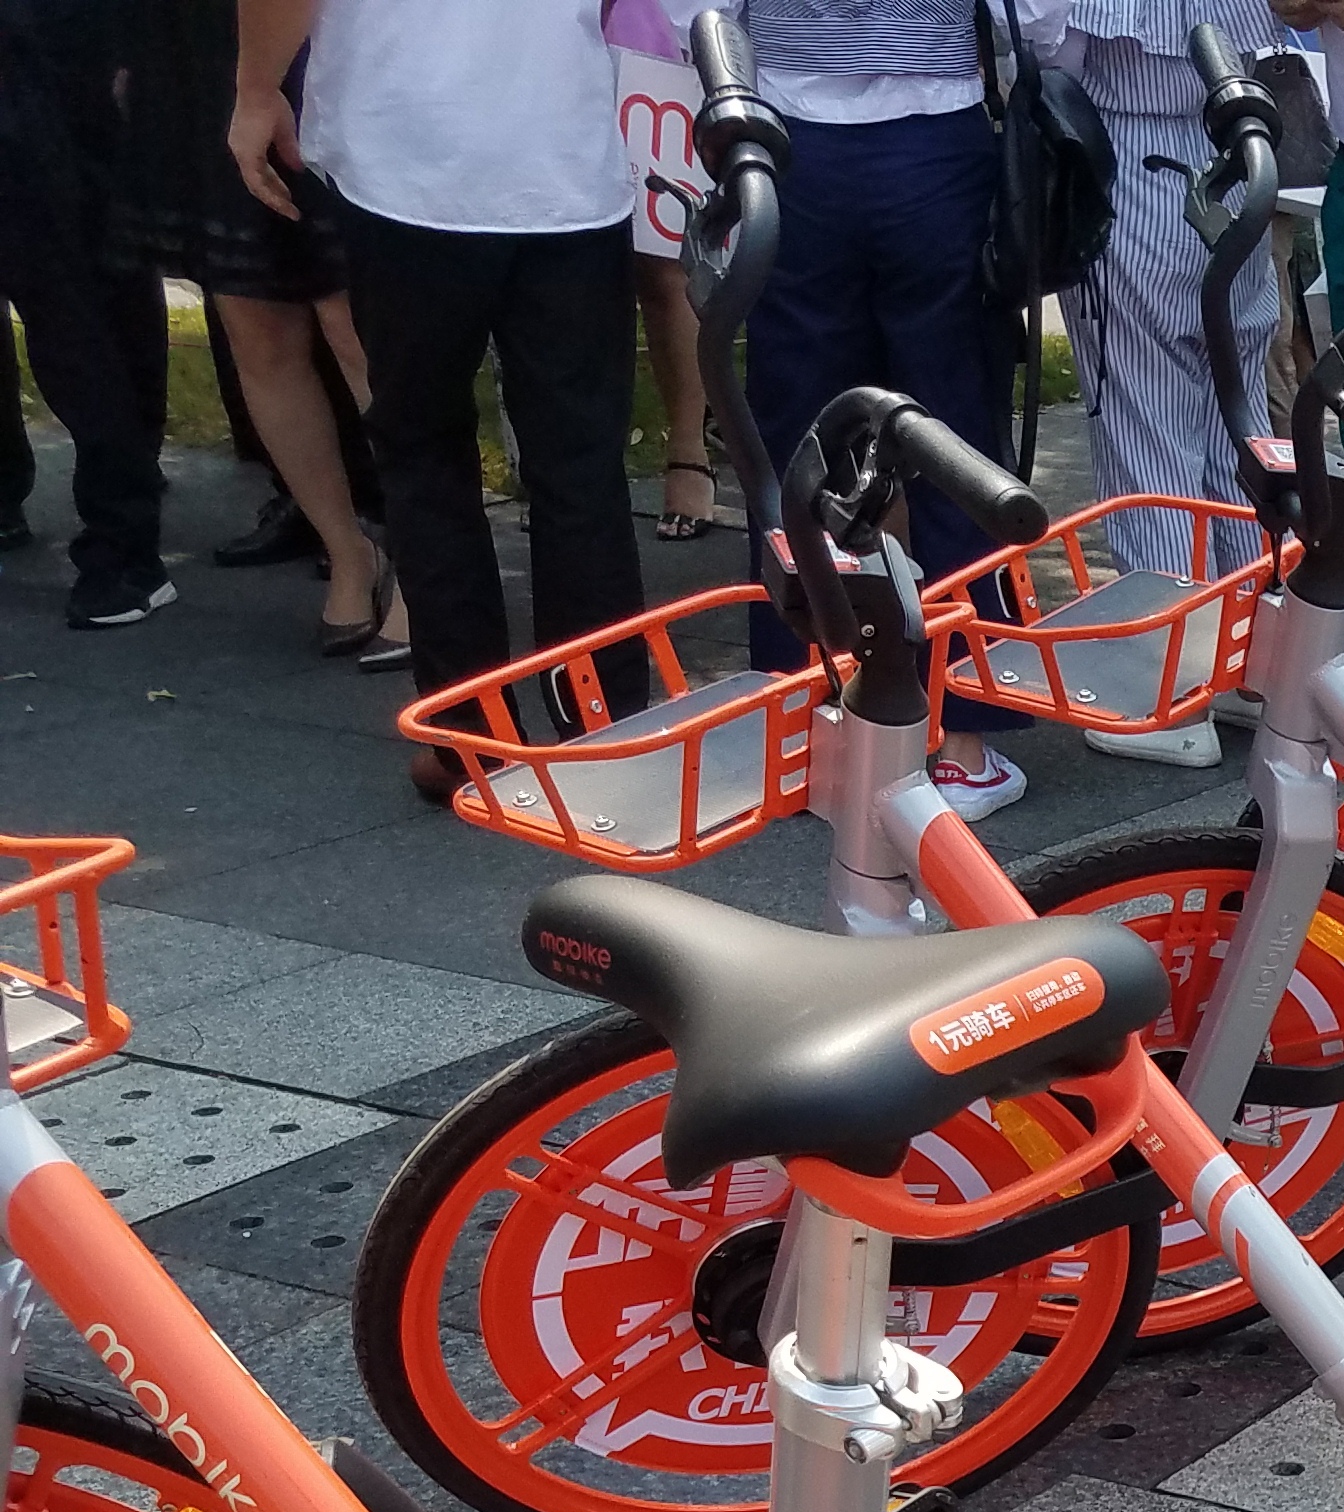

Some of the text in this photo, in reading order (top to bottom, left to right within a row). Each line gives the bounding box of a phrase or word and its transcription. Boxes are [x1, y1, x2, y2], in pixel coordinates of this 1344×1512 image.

[539, 930, 612, 970] mobike
[928, 1001, 1016, 1055] 1元骑车
